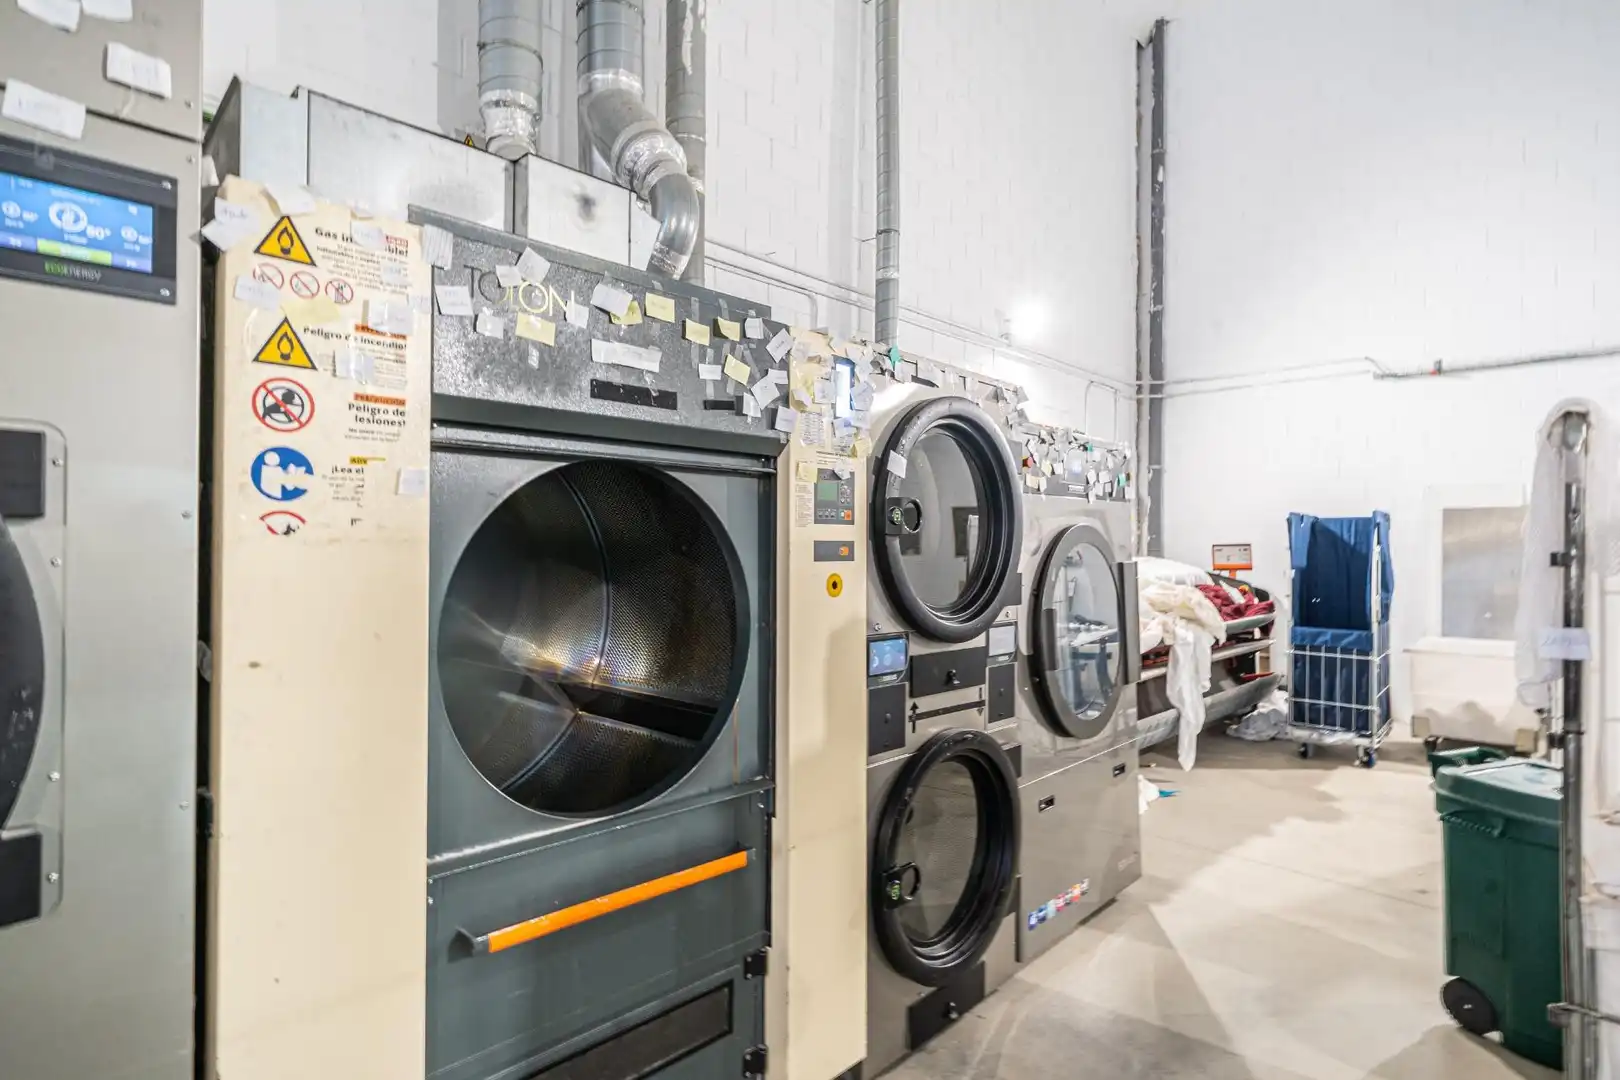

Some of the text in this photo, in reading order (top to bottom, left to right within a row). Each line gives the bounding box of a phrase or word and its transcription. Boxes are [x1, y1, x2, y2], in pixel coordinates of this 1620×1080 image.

[315, 227, 338, 240] Gas
[303, 326, 342, 341] Peligro
[348, 403, 406, 417] Peligro de
